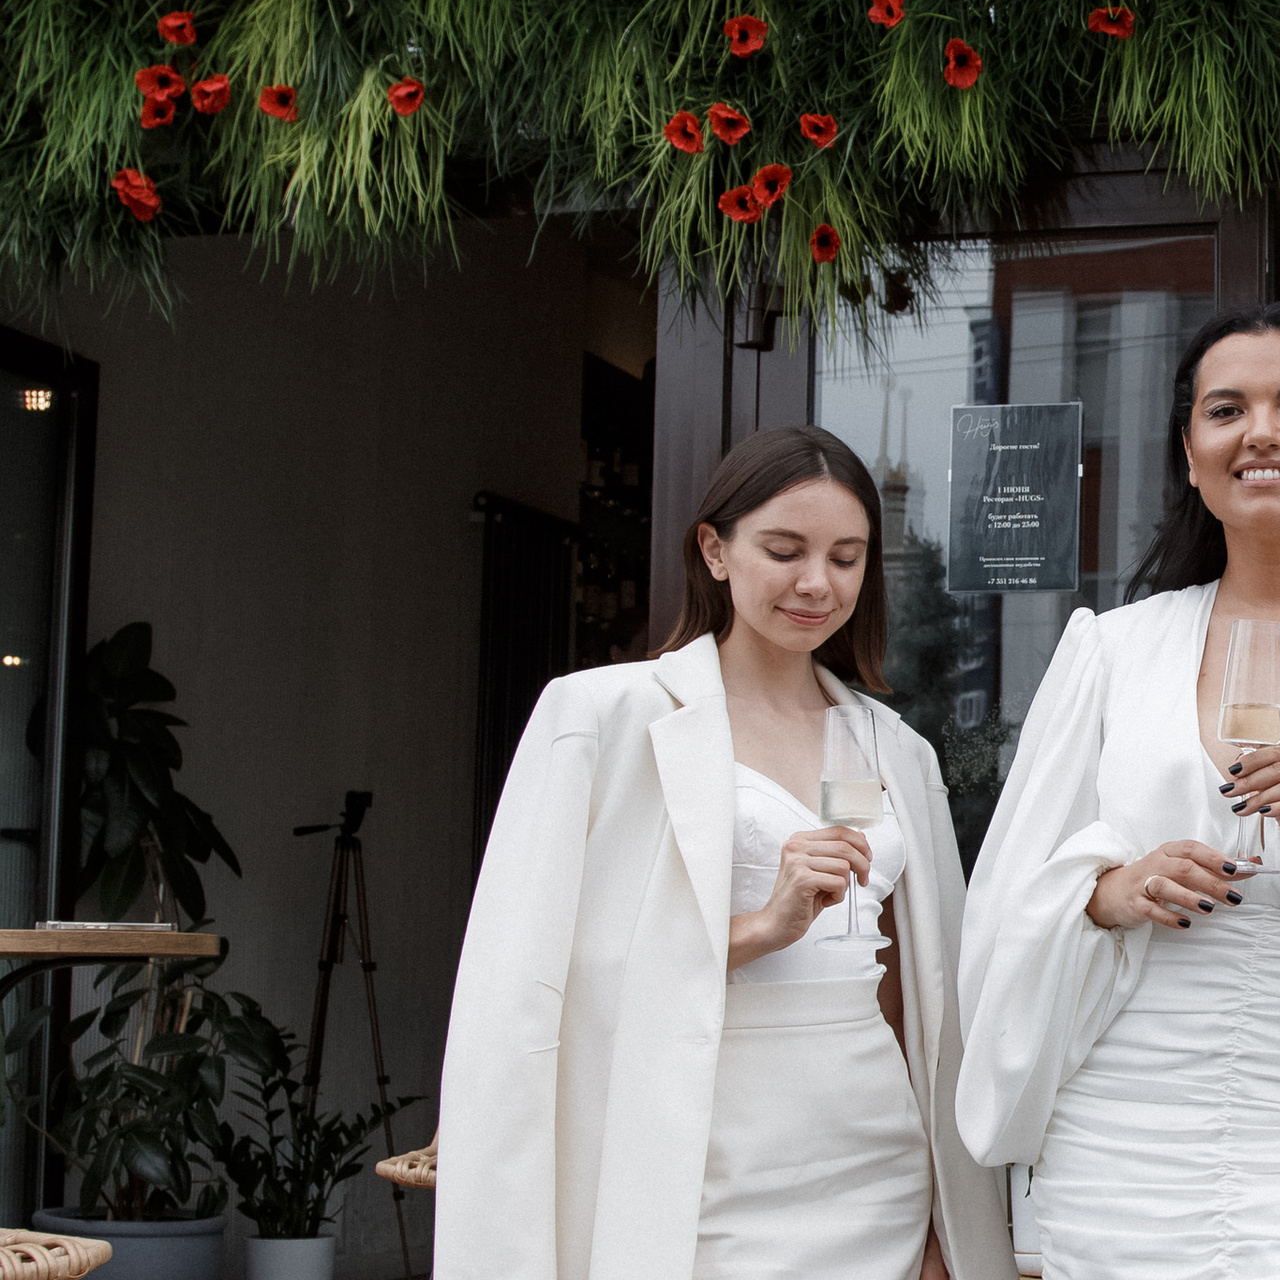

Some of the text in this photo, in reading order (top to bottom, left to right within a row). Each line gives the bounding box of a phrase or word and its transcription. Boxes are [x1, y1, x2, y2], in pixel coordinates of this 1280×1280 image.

[989, 442, 1040, 452] Дорогие гости!
[983, 495, 1014, 504] Ресторан
[988, 512, 1038, 521] будет работать
